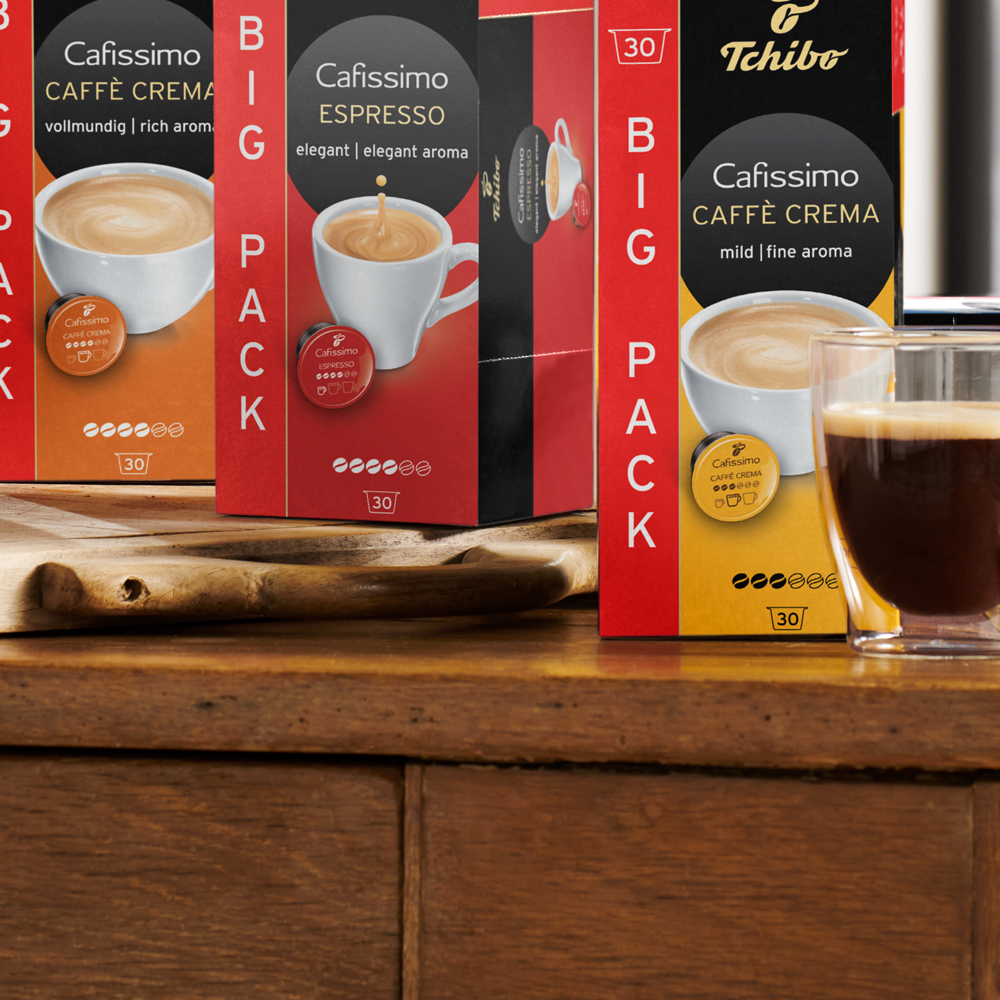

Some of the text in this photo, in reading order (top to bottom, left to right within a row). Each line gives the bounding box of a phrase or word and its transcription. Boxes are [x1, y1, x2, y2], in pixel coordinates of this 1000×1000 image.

[64, 41, 201, 66] Cafissimo
[624, 37, 656, 57] 30
[720, 40, 849, 72] Tchibo
[316, 62, 449, 89] Cafissimo
[45, 76, 124, 101] CAFFÈ
[319, 104, 445, 125] ESPRESSO
[45, 119, 214, 135] vollmundig rich arom
[296, 144, 469, 160] elegant elegant aroma
[712, 161, 859, 189] Cafissimo
[692, 199, 880, 225] CAFFÈ CREMA
[238, 16, 266, 431] BIG PACK
[720, 243, 853, 259] mild fine aroma
[64, 315, 109, 328] Cafissimo
[626, 117, 657, 548] BIG PACK
[315, 346, 358, 358] Cafissimo
[318, 360, 355, 370] ESPRESSO
[124, 458, 145, 471] 30
[712, 456, 761, 469] Cafissimo
[735, 469, 762, 480] CREMA
[372, 496, 392, 510] 30
[776, 612, 799, 626] 30
